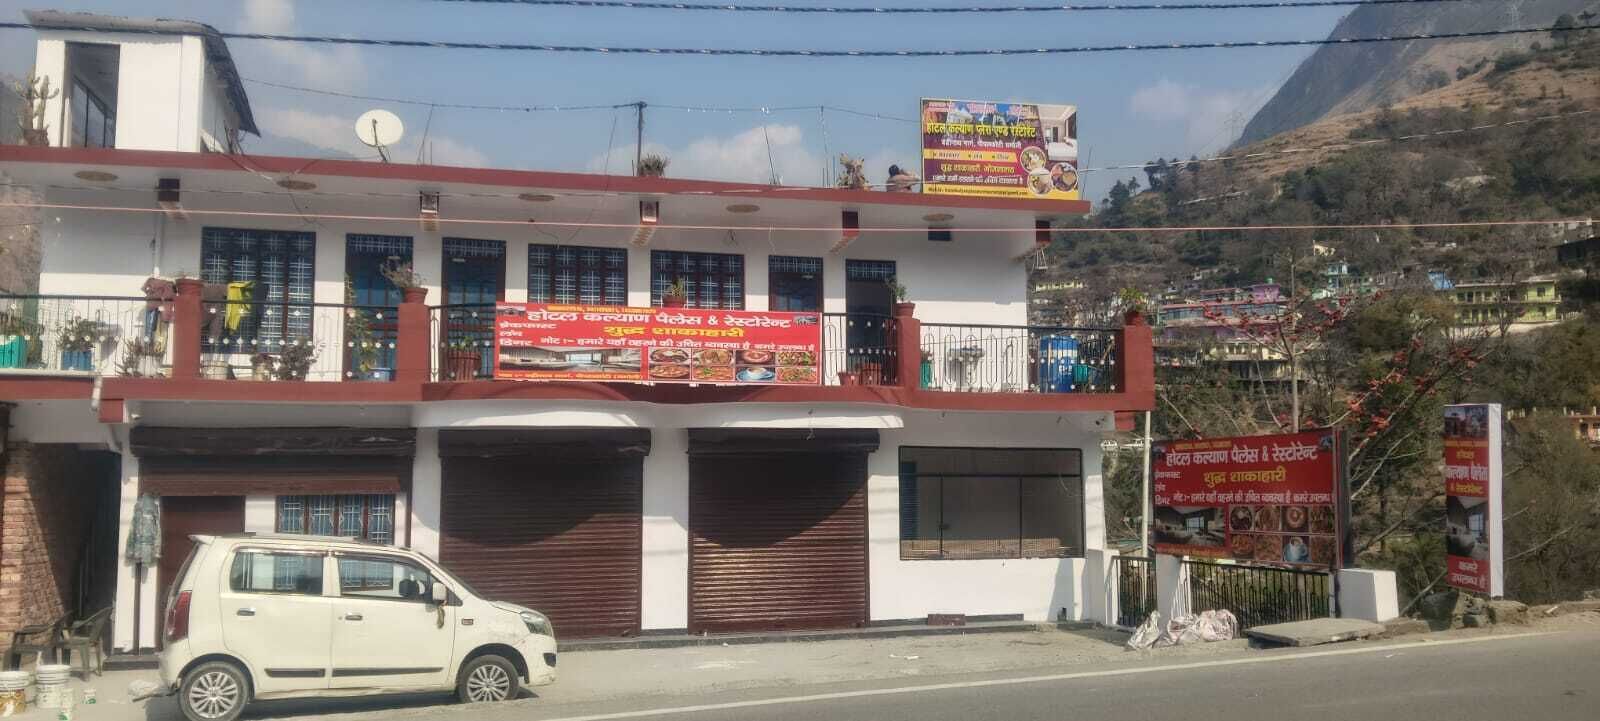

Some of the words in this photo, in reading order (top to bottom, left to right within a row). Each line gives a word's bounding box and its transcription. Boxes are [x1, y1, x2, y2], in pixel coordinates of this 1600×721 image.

[926, 121, 946, 136] होटल
[527, 308, 578, 322] होटल
[583, 311, 650, 323] कल्याण
[655, 312, 703, 326] पैलेस
[707, 315, 719, 326] &
[603, 326, 646, 337] शुद्ध
[651, 326, 745, 338] शाकाहारी
[577, 337, 604, 346] हमारे
[659, 338, 673, 347] की
[1166, 449, 1191, 467] होटल
[1192, 449, 1228, 465] कल्याण
[1230, 443, 1259, 464] पैलेस
[1203, 471, 1227, 488] शुद्ध
[1229, 465, 1287, 484] शाकाहारी
